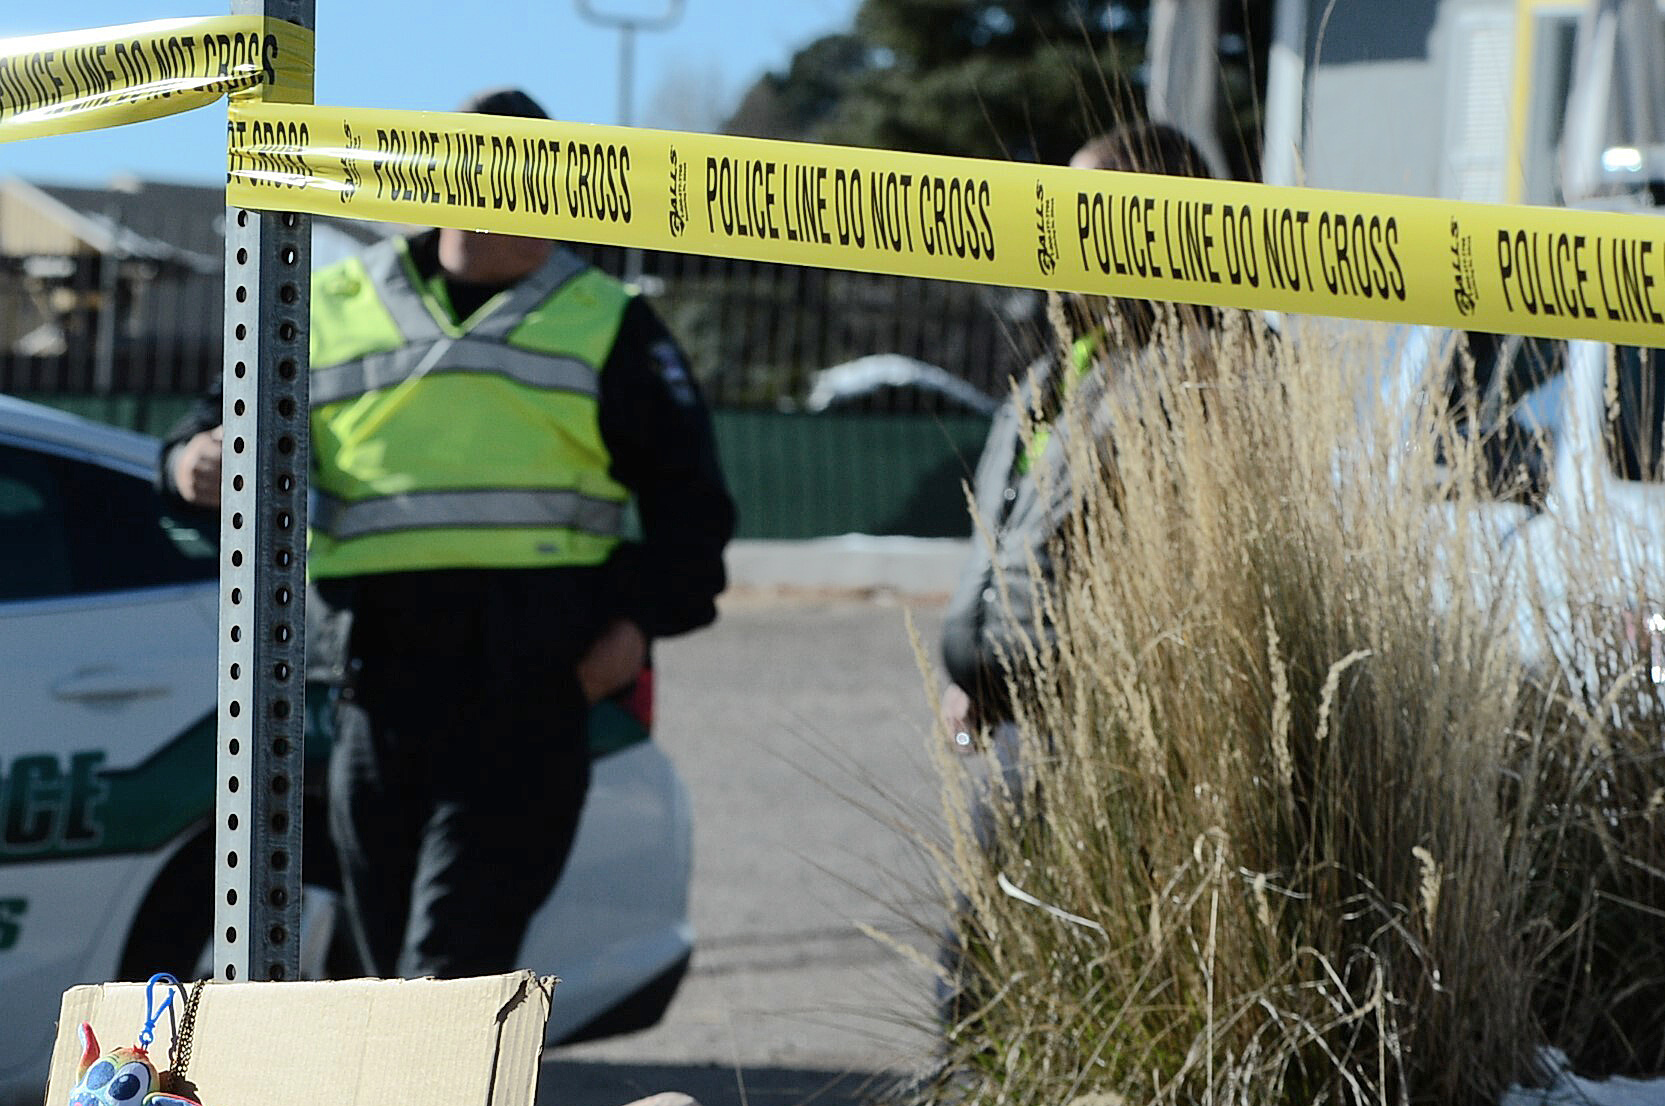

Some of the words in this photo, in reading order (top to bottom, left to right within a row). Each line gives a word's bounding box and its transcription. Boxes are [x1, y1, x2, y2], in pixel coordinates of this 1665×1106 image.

[62, 46, 116, 104] LINE
[114, 40, 152, 92] DO
[151, 36, 195, 80] NOT
[203, 32, 278, 85] CROSS
[376, 128, 440, 203] POLICE
[445, 132, 486, 208] LINE
[492, 135, 516, 212] DO
[523, 139, 560, 215] NOT
[566, 140, 632, 223] CROSS
[706, 156, 780, 239] POLICE
[783, 163, 831, 244] LINE
[835, 168, 865, 249] DO
[871, 171, 914, 252] NOT
[919, 174, 995, 261] CROSS
[1077, 192, 1162, 278] POLICE
[1164, 199, 1221, 284] LINE
[1223, 204, 1259, 288] DO
[1262, 207, 1314, 292] NOT
[1318, 211, 1406, 301] CROSS
[1498, 229, 1598, 319] POLICE
[1597, 237, 1664, 324] LINE
